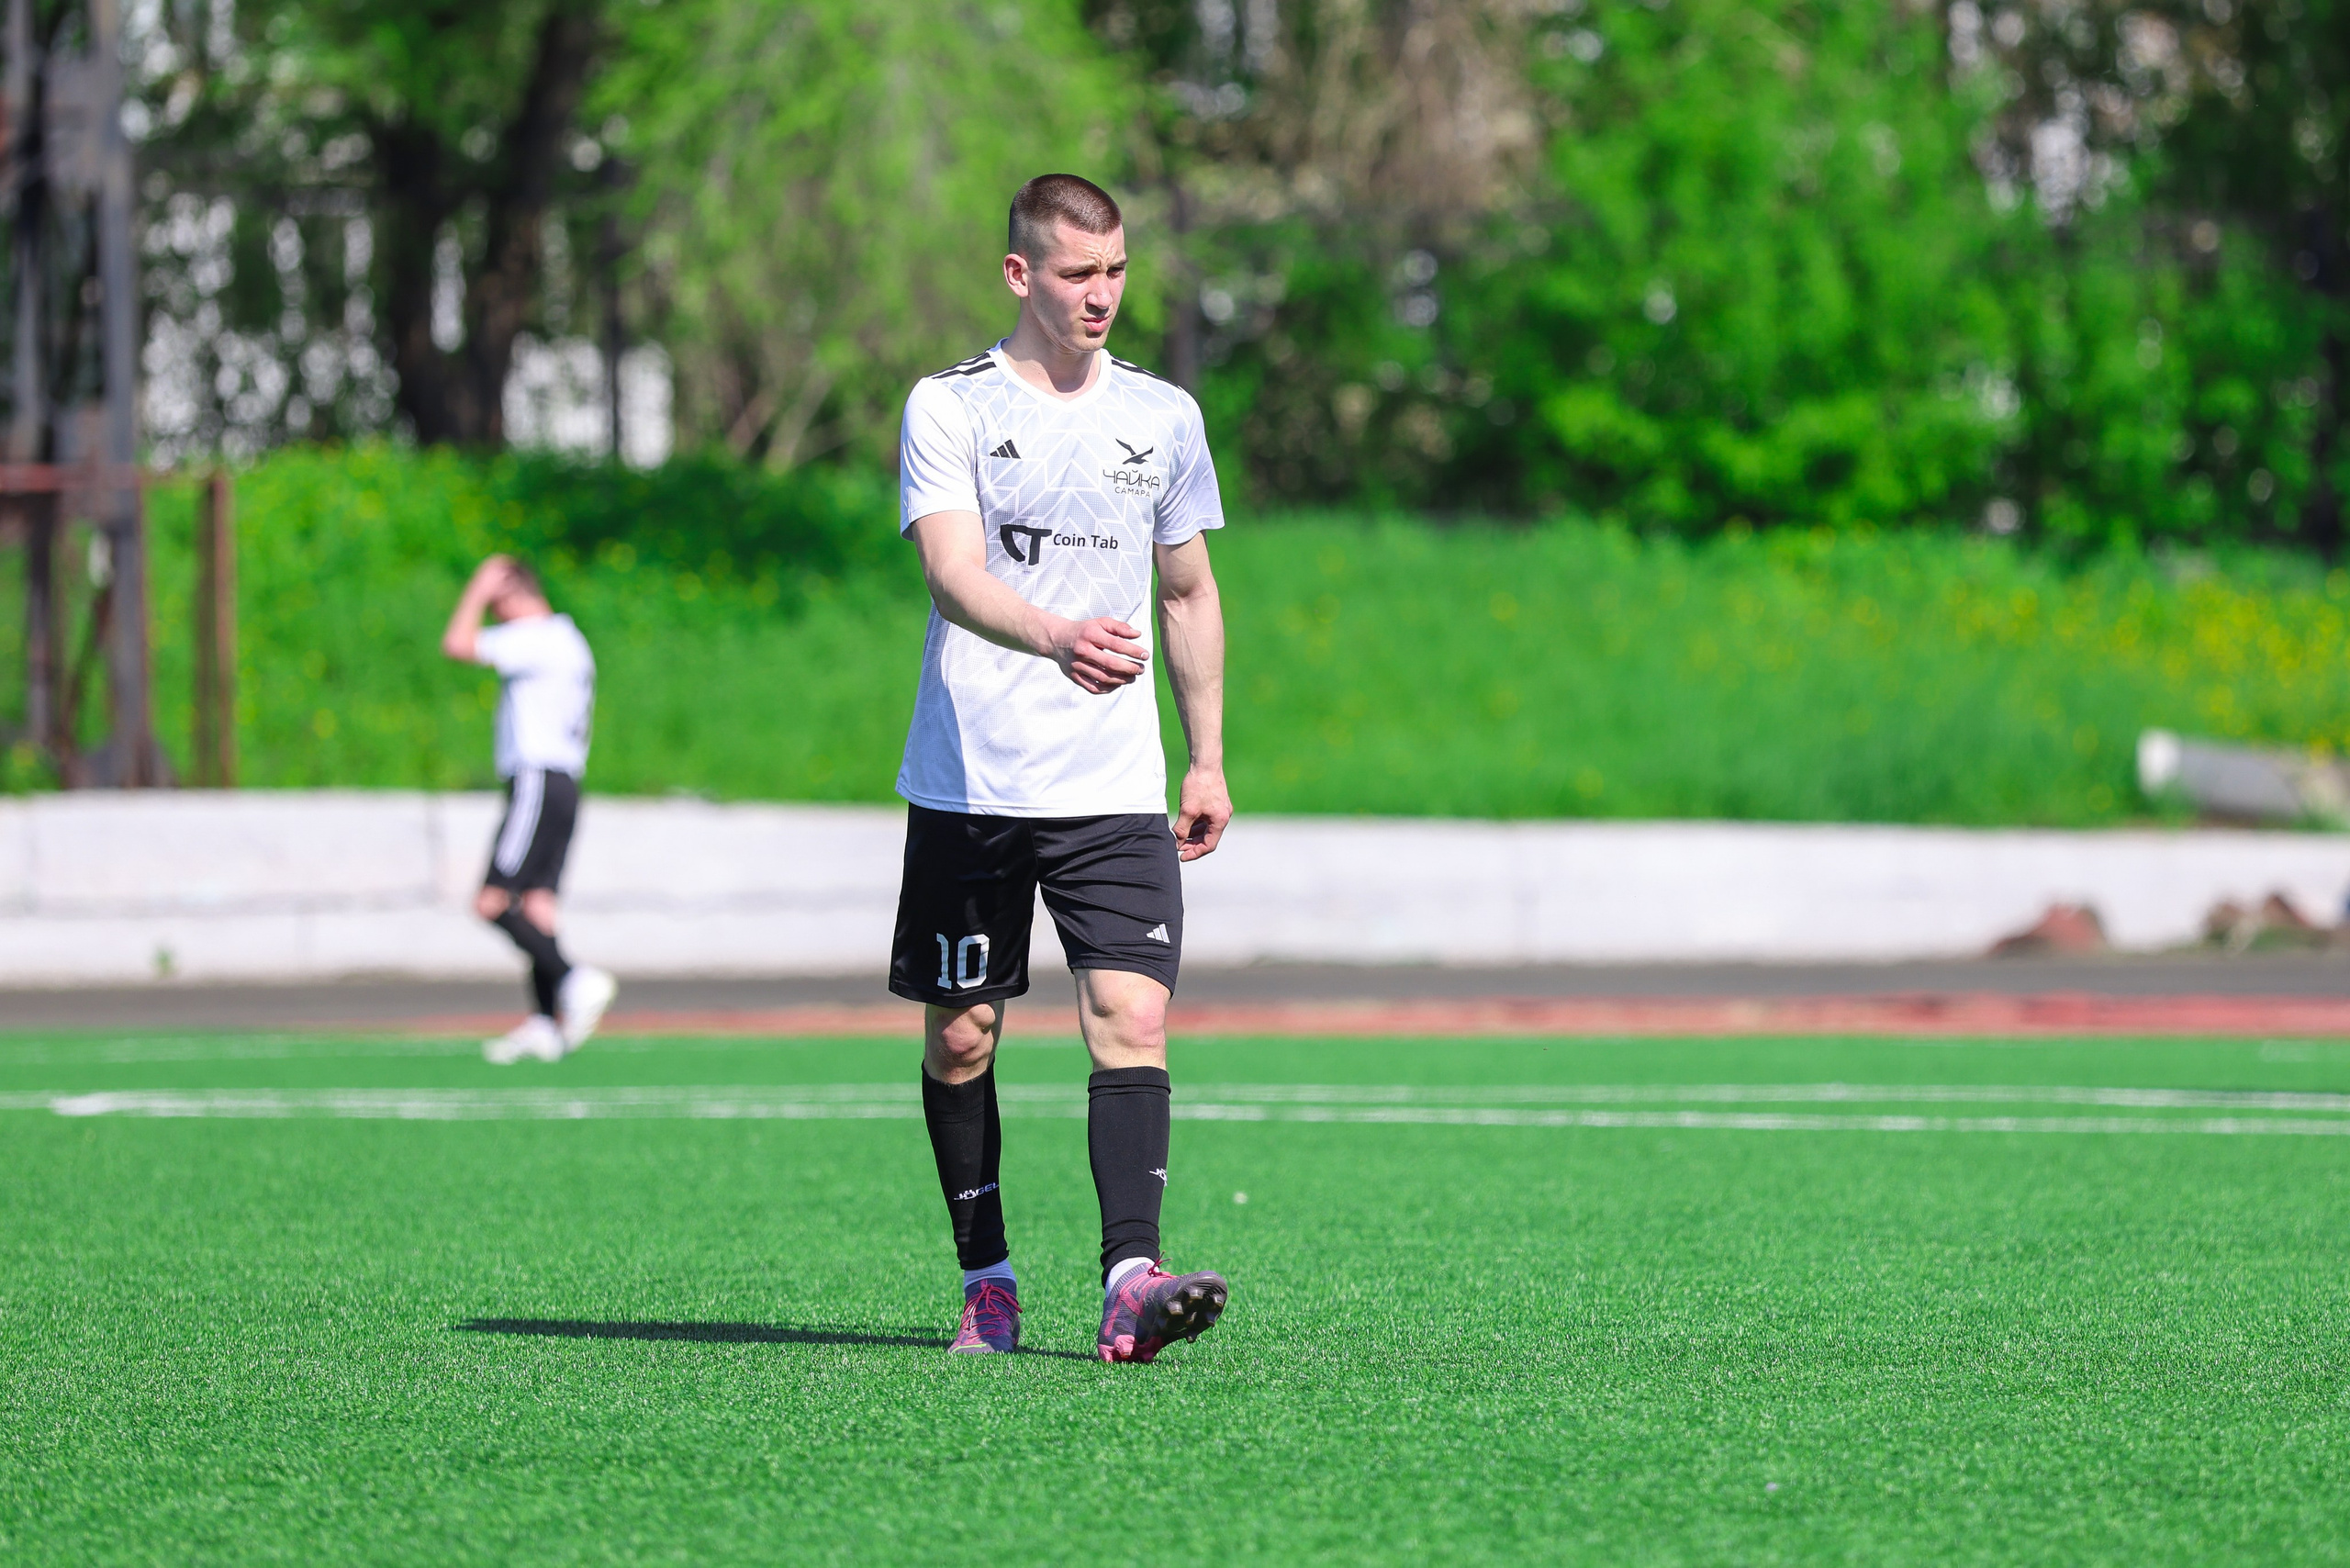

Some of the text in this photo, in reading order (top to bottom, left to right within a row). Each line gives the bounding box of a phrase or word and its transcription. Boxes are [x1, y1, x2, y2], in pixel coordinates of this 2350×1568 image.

[1102, 469, 1160, 490] ЧАЙКА
[1114, 486, 1151, 498] САМАРА
[1053, 533, 1086, 547] Coin
[1091, 534, 1119, 550] Tab
[936, 933, 990, 990] 10
